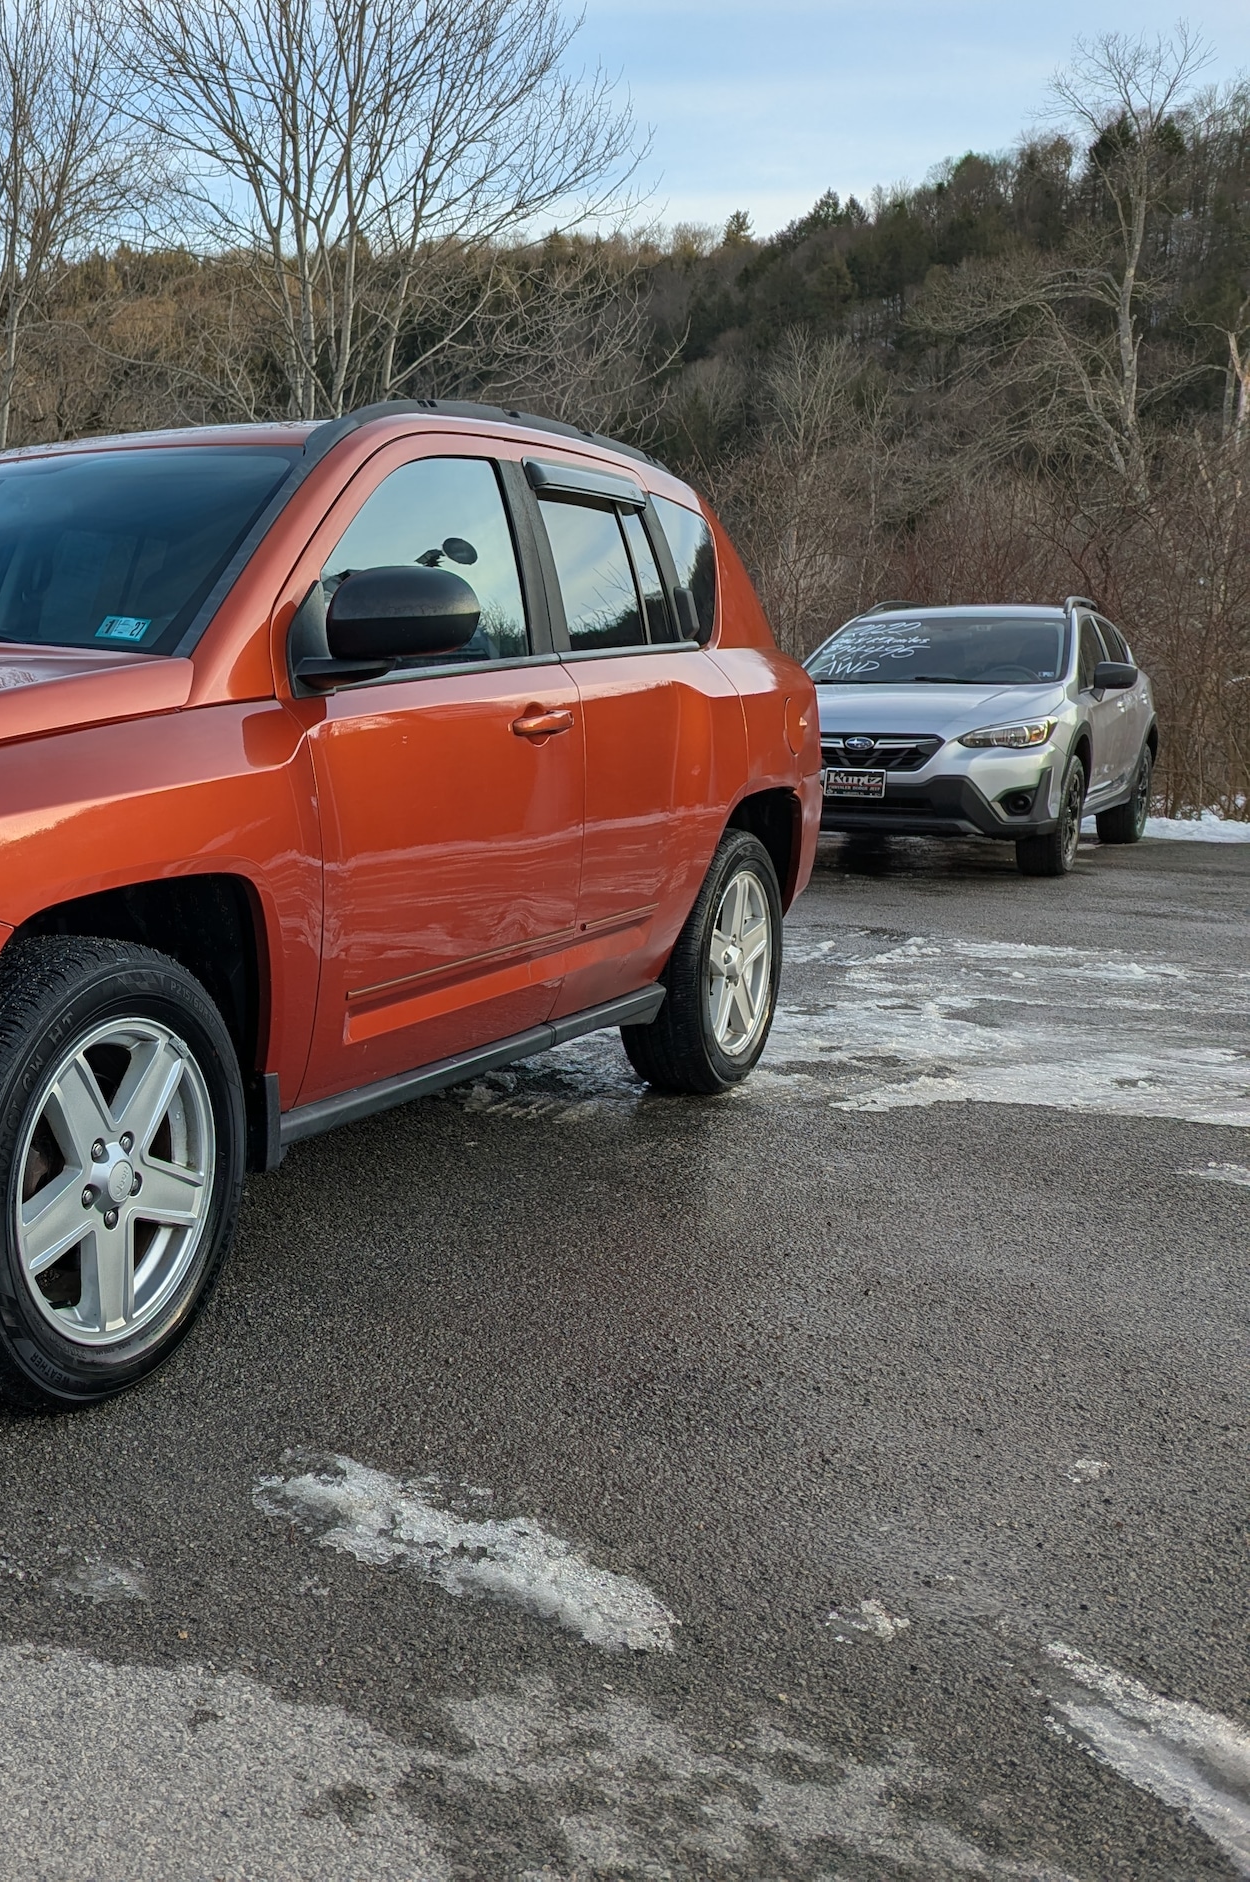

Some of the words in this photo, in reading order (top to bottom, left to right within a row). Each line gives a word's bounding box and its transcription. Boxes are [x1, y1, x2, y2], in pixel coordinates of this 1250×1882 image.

[129, 621, 146, 637] 27
[828, 772, 882, 786] Kuntz
[48, 1009, 75, 1047] HT
